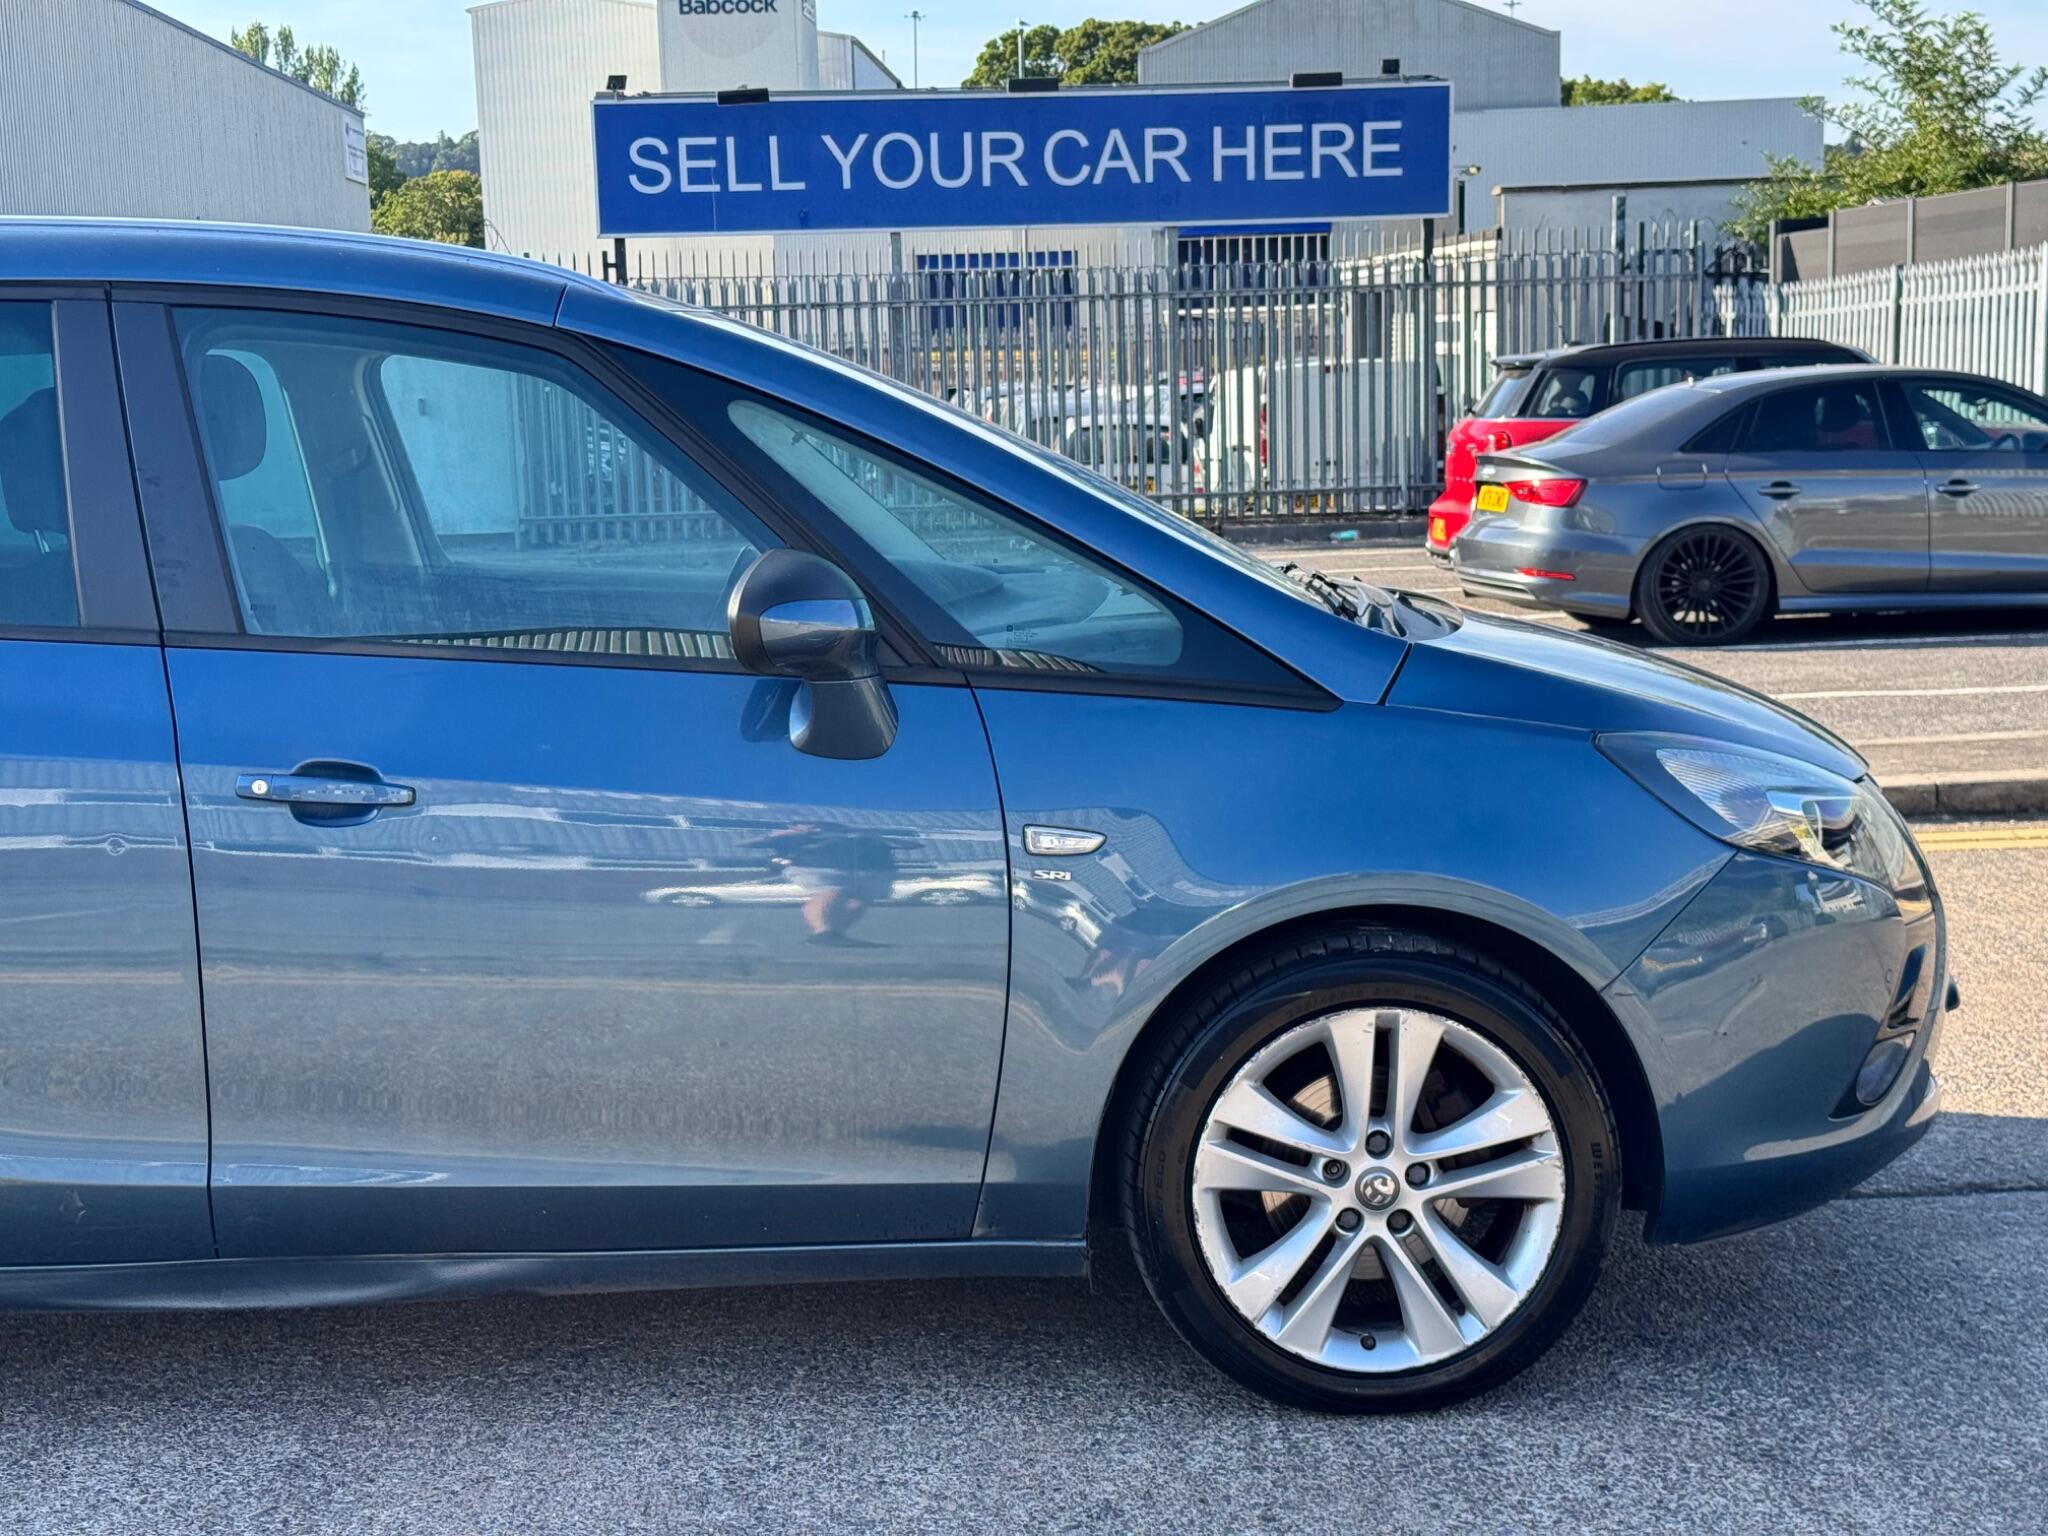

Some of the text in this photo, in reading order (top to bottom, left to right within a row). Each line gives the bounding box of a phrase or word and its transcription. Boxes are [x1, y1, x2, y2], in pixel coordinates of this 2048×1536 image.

[679, 0, 777, 15] Babcock
[627, 119, 1404, 196] SELL YOUR CAR HERE
